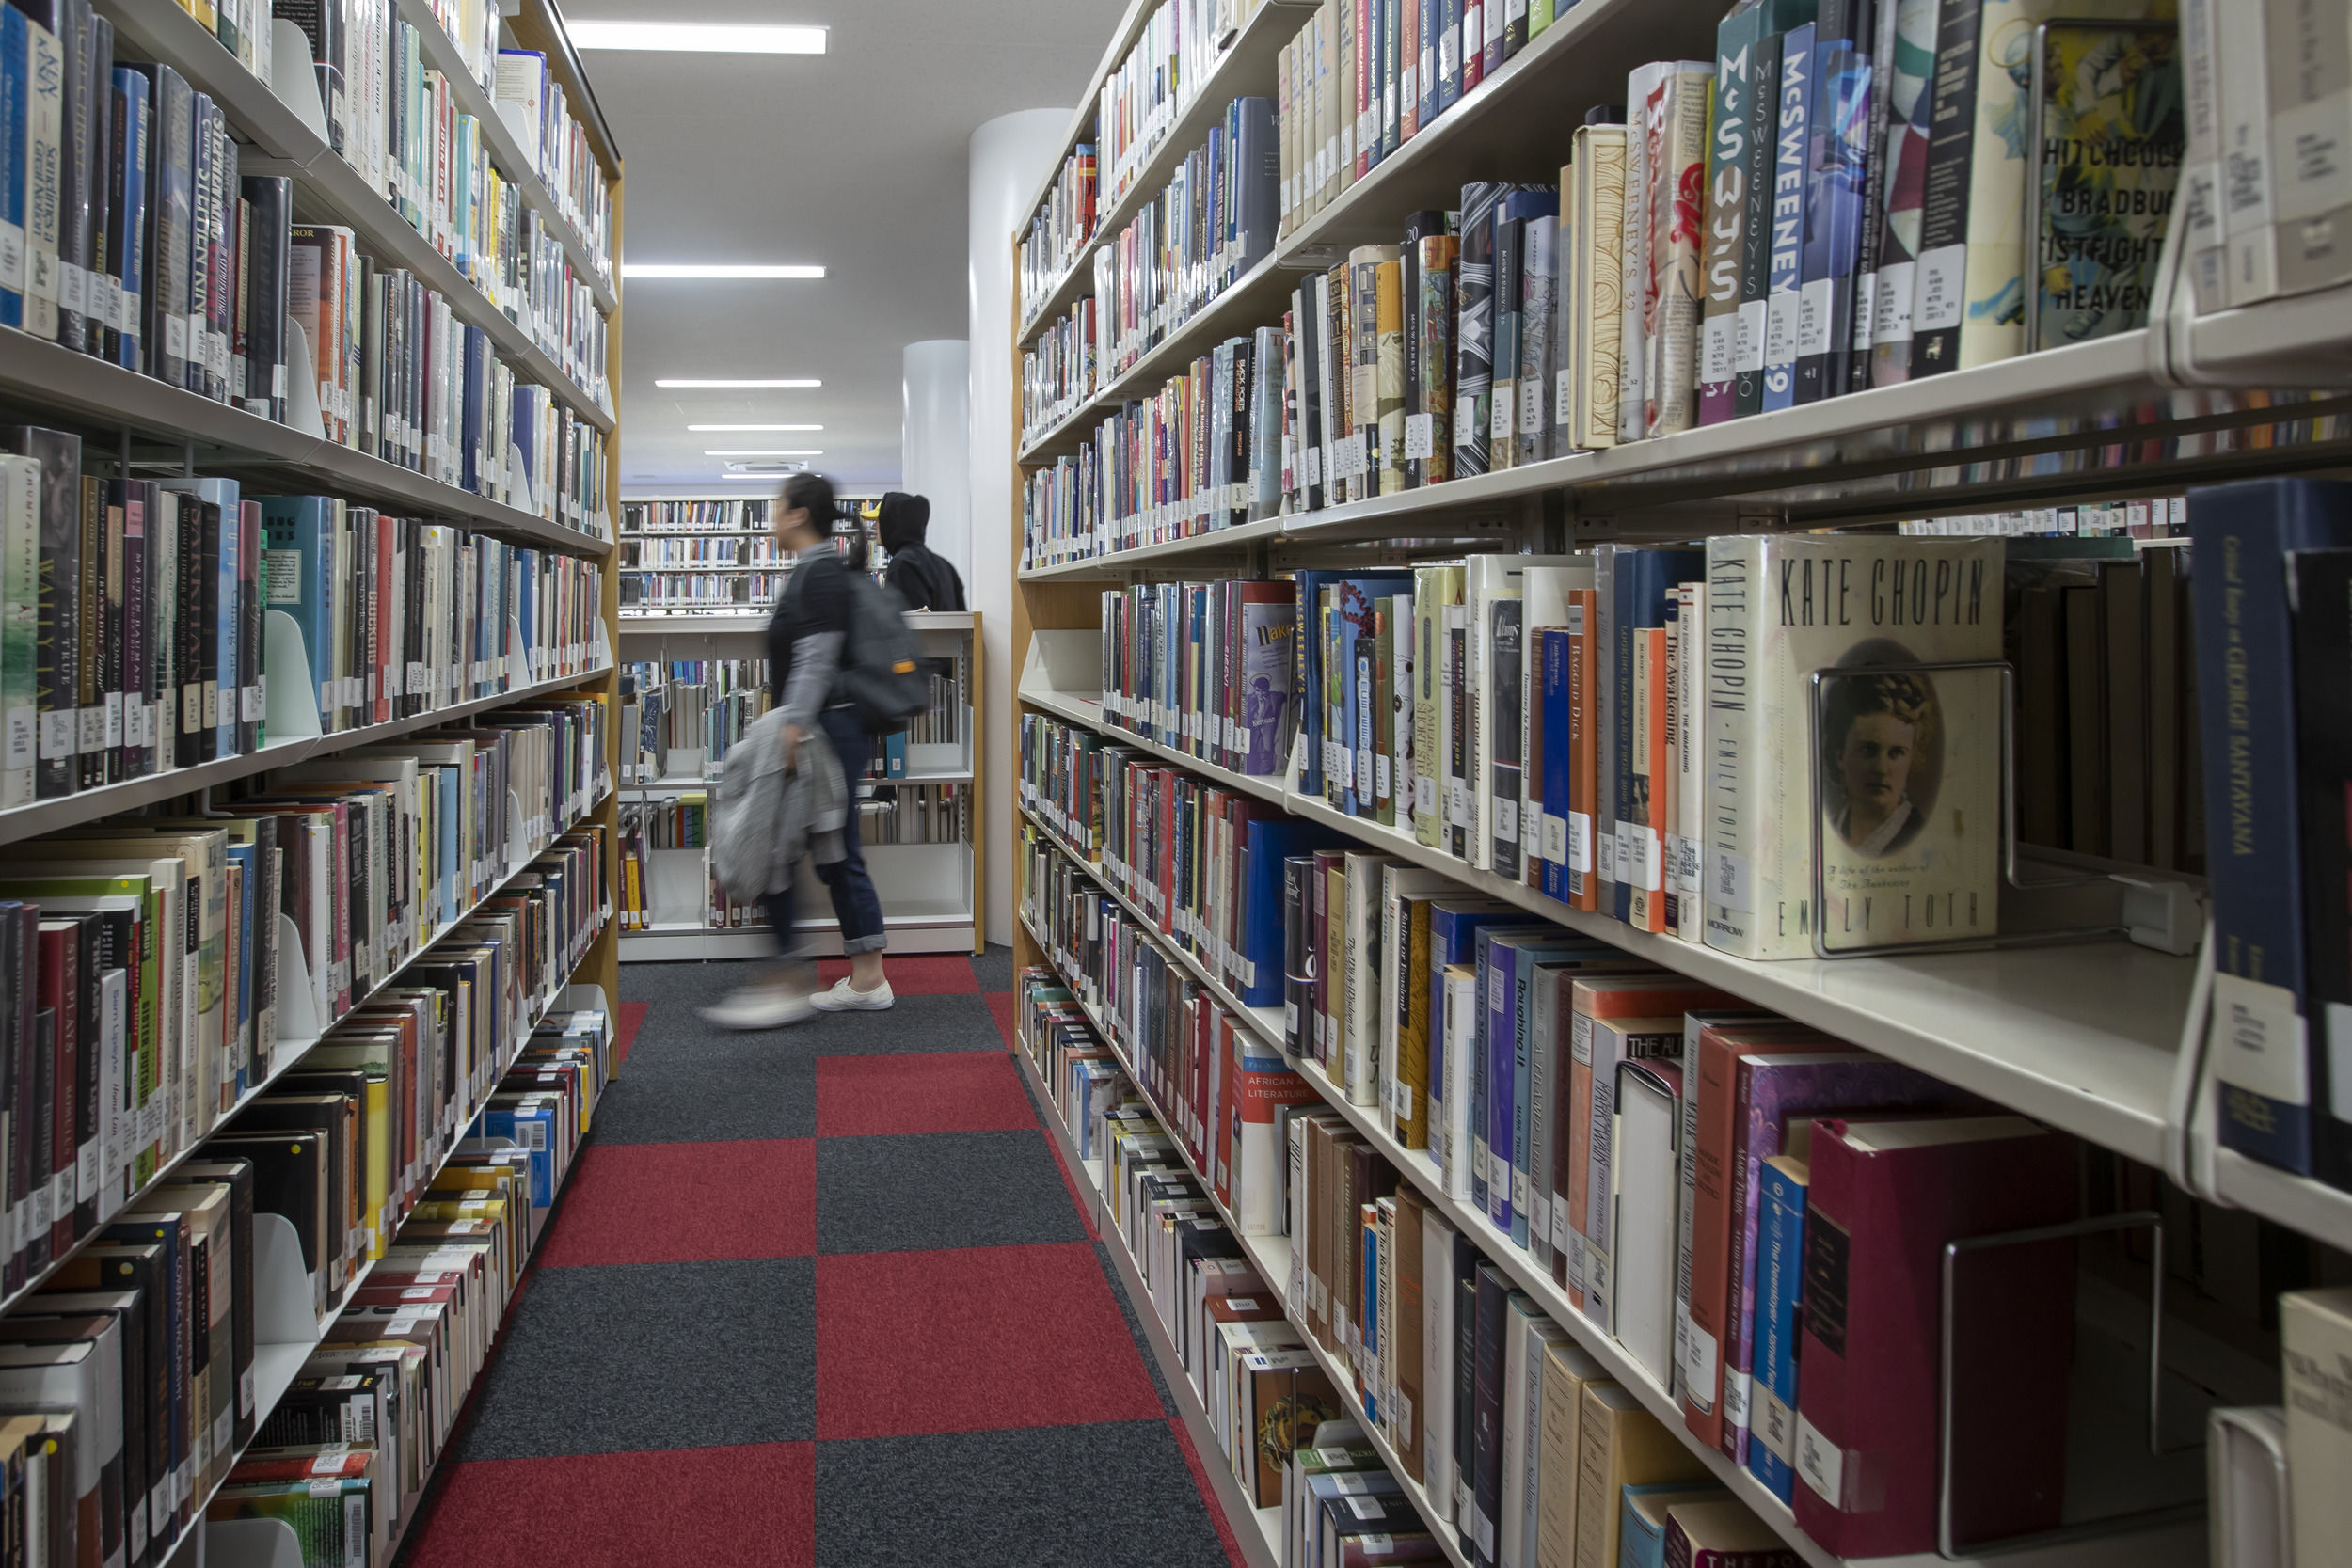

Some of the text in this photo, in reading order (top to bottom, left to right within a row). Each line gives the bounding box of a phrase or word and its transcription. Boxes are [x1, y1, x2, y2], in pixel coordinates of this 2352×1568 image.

[211, 117, 225, 198] STEPHEN
[195, 166, 211, 265] STEPHEN
[1624, 110, 1642, 311] McSWEENEY'S 32
[135, 551, 143, 612] MARTIN
[1780, 559, 1984, 626] KATE CHOPIN
[1711, 557, 1747, 711] KATE CHOPIN
[60, 640, 72, 686] TRUE
[1572, 644, 1581, 741] RAGGED DICK
[1664, 631, 1679, 745] The Awakening
[1717, 736, 1738, 792] EMILY
[2228, 735, 2256, 855] SANTAYANA
[1717, 805, 1737, 851] TOTH
[1400, 911, 1408, 943] Satire
[1707, 917, 1744, 938] MORROW
[1903, 892, 1978, 929] TOTH
[66, 942, 76, 978] SIX
[91, 936, 102, 976] THE
[1477, 942, 1486, 971] Life
[65, 989, 75, 1053] PLAYS
[91, 981, 101, 1022] ASK
[112, 989, 120, 1021] Sam
[1516, 978, 1527, 1051] Roughing
[1628, 1037, 1660, 1057] THE
[1248, 1076, 1294, 1086] AFRICAN
[1248, 1089, 1309, 1100] LITERATURE
[1594, 1078, 1613, 1118] MARK
[1515, 1102, 1523, 1130] MARK
[1592, 1119, 1612, 1168] TWAIN
[1684, 1099, 1698, 1191] MARK TWAIN
[1378, 1230, 1388, 1251] The
[1378, 1254, 1388, 1277] Red
[1377, 1279, 1388, 1315] Badge
[1768, 1241, 1782, 1363] The Deerslayer James
[1377, 1334, 1388, 1379] Courage
[1525, 1370, 1538, 1516] The Dickinson Sublime
